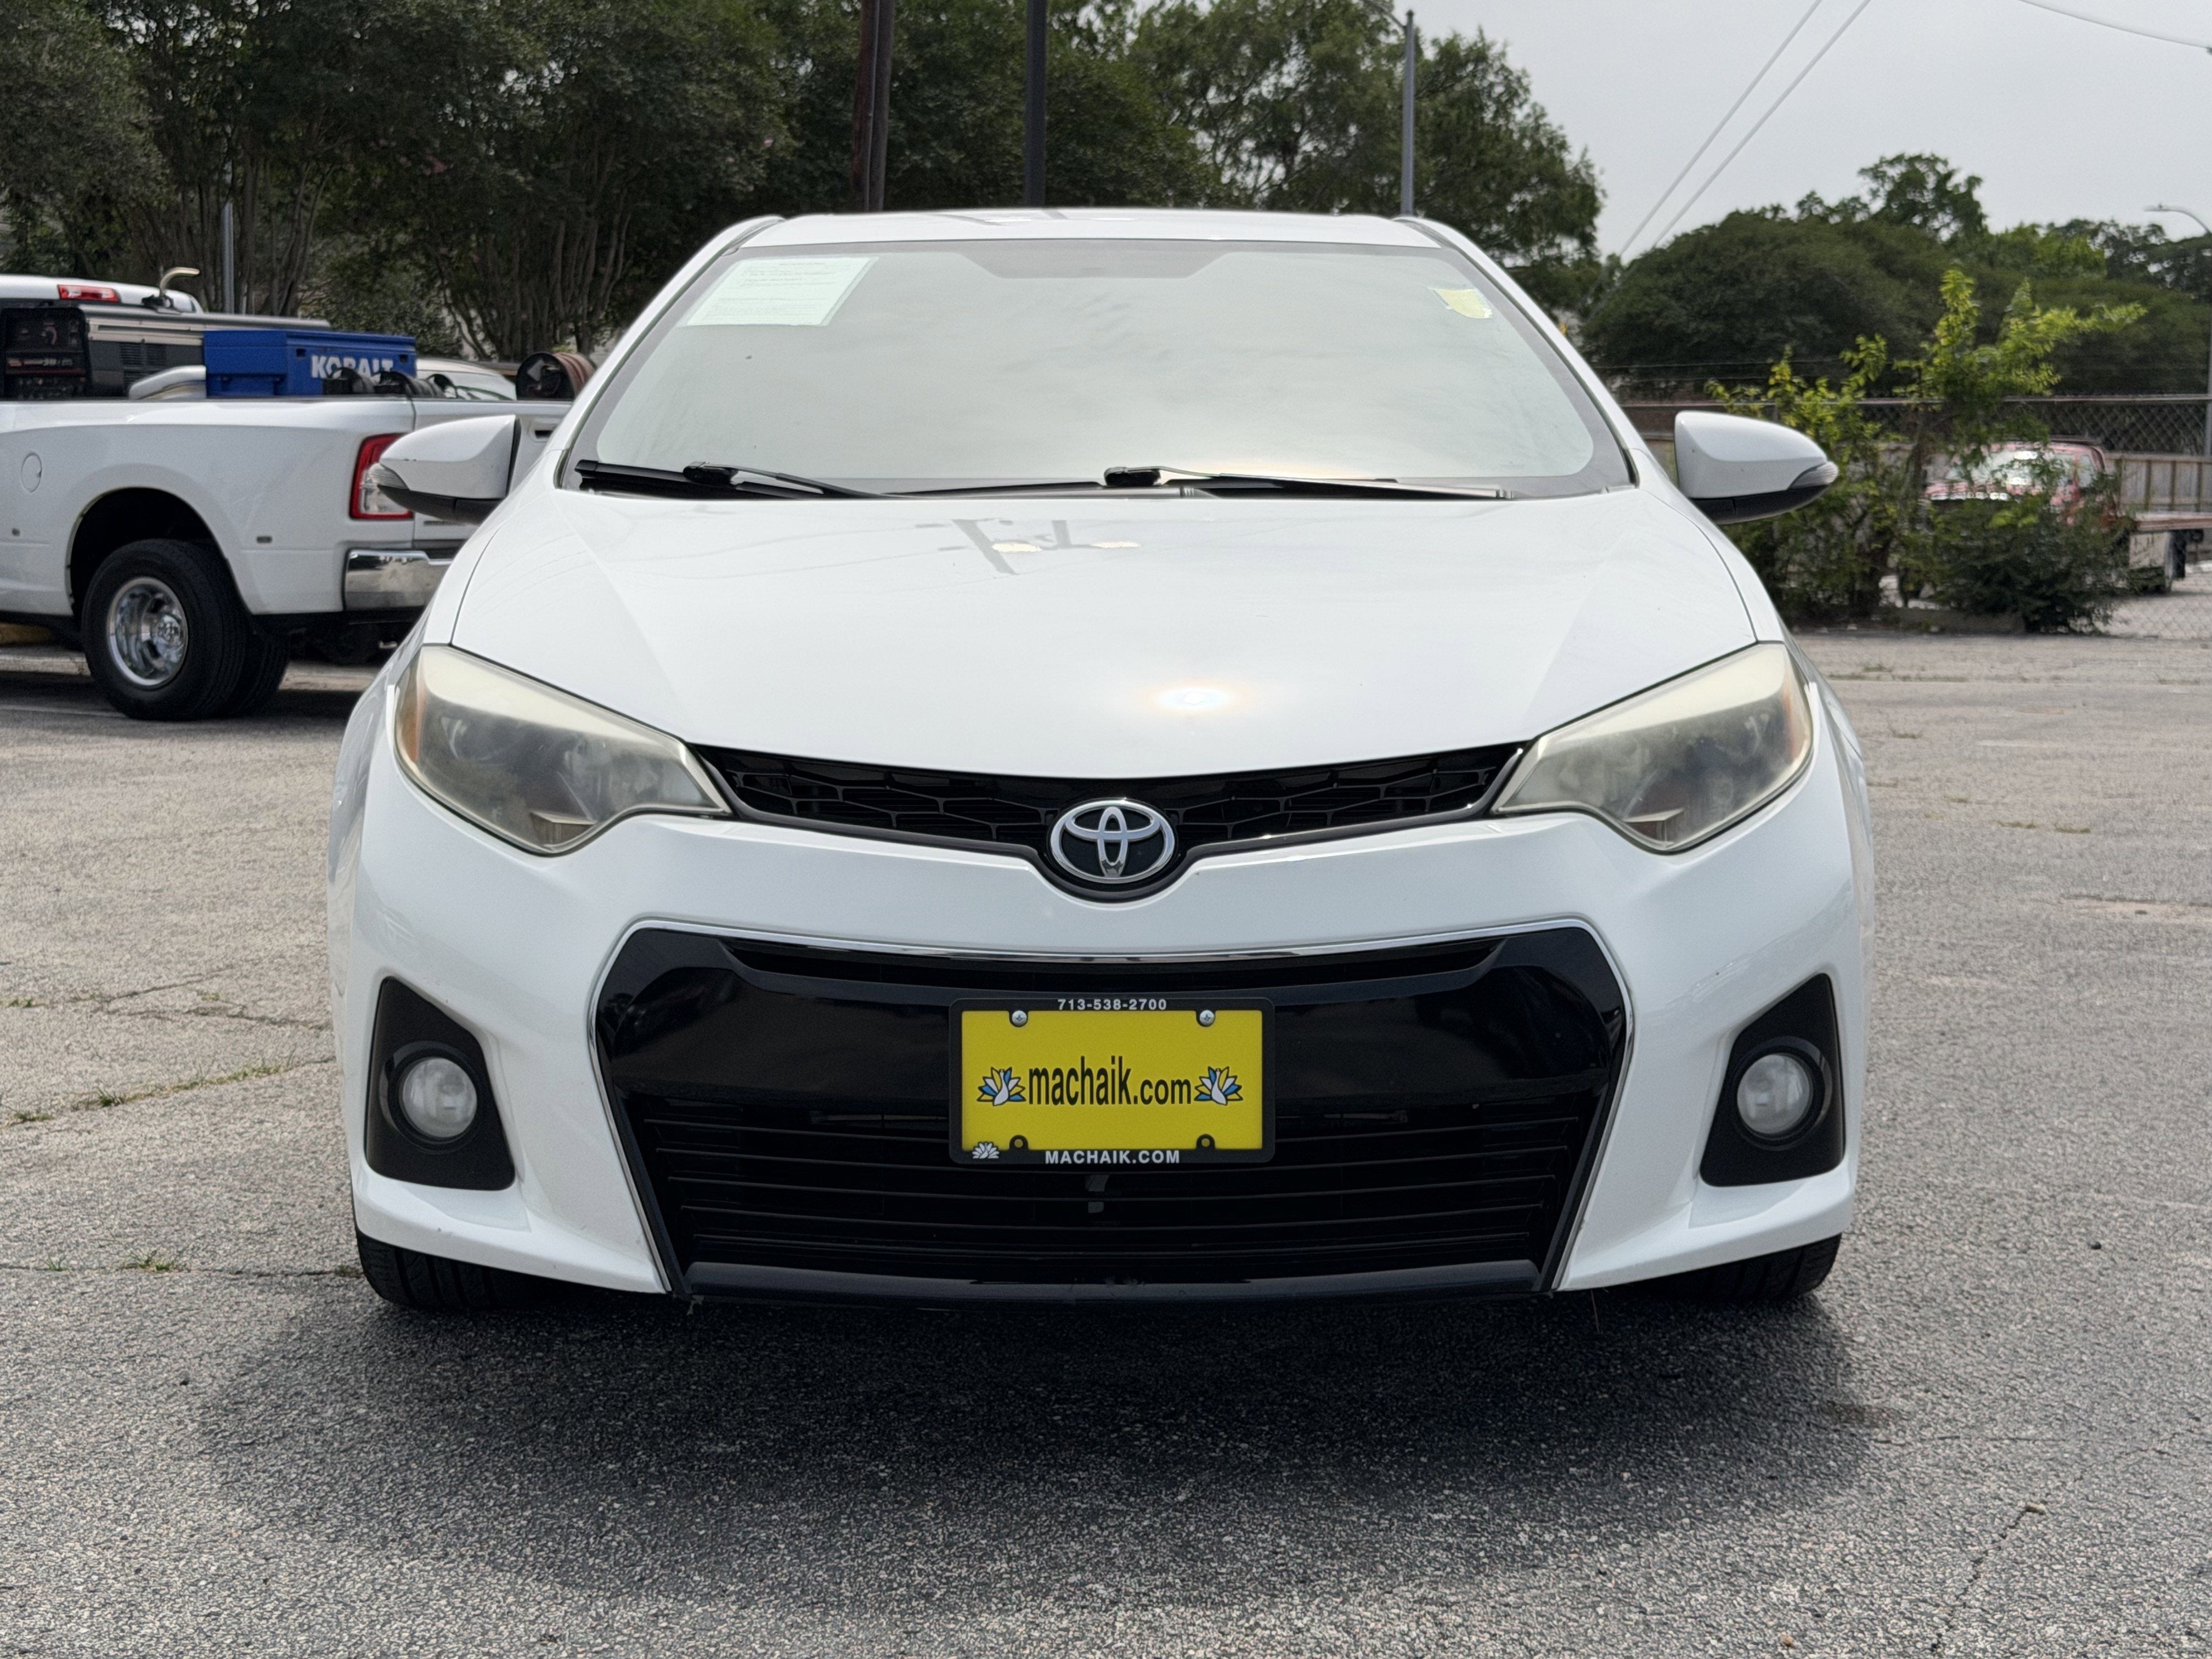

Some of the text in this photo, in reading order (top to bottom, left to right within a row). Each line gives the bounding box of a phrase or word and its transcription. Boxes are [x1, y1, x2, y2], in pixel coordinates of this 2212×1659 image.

[1057, 998, 1167, 1010] 713-538-2700
[1029, 1056, 1192, 1105] machaik.com
[1045, 1150, 1180, 1164] MACHAIK.COM
